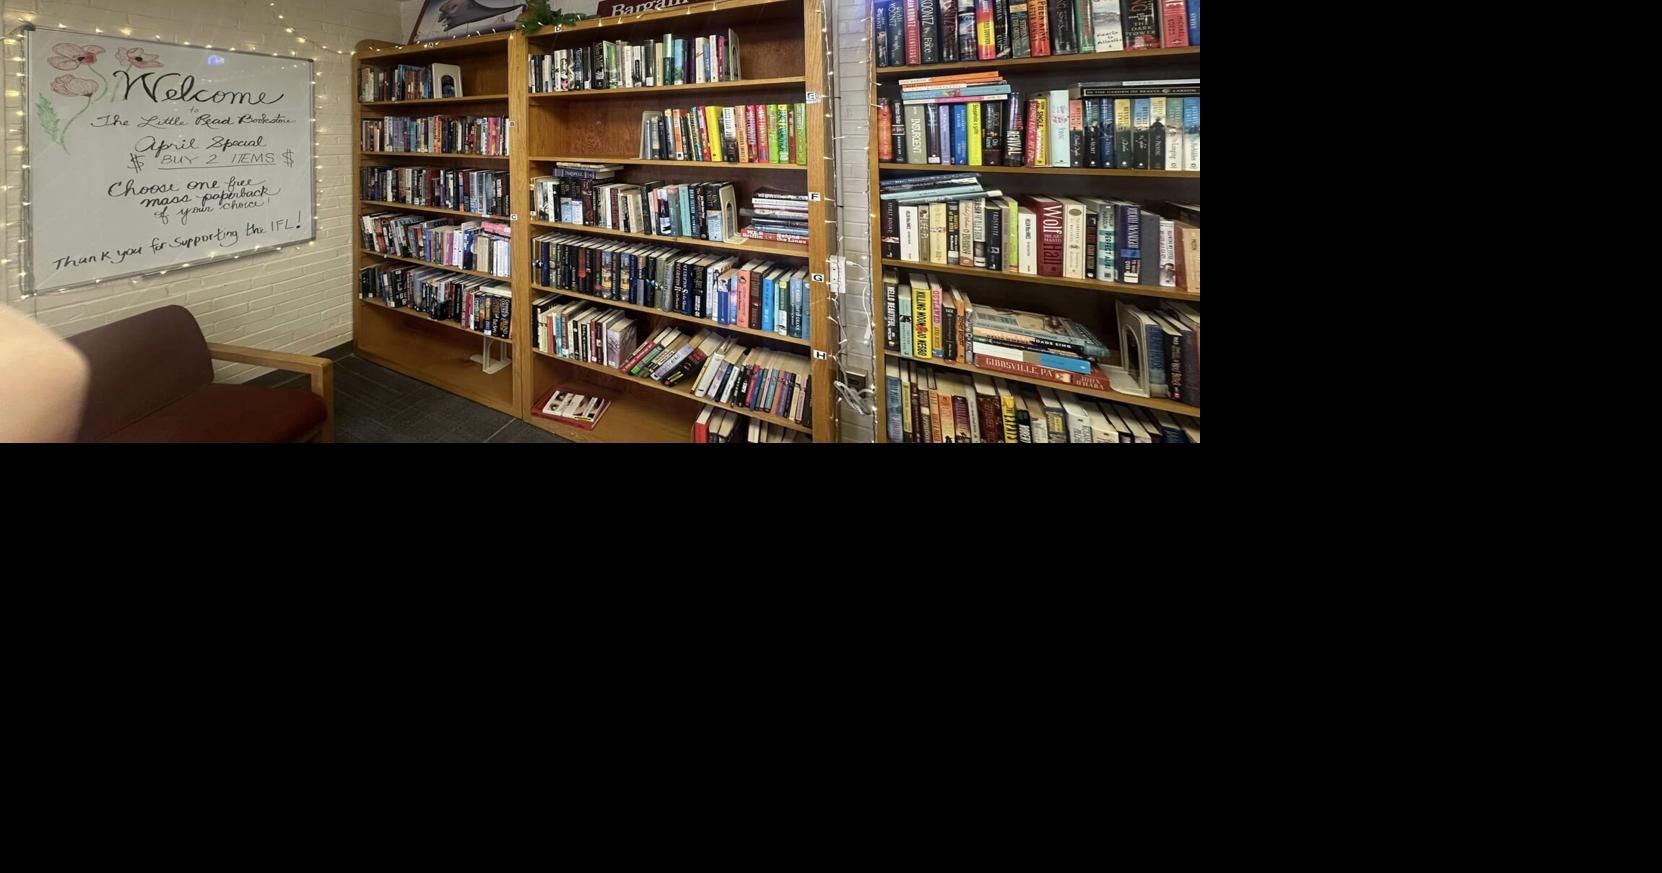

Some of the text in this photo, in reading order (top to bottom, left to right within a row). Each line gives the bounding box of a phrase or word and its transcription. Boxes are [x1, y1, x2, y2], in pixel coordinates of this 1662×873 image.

[113, 70, 285, 105] Welcome
[807, 92, 815, 100] E
[90, 115, 129, 127] The
[137, 114, 188, 128] Little
[189, 105, 199, 113] to
[911, 118, 922, 153] INSURGENT
[1007, 130, 1023, 156] REVIVAL
[134, 136, 267, 160] April Special
[127, 149, 294, 173] $ BUY 2 ITEMS $
[107, 176, 266, 198] Choose one free
[139, 186, 281, 208] mass paperback
[154, 204, 169, 225] of
[176, 204, 214, 226] your
[1043, 204, 1063, 234] Wolf
[53, 251, 112, 271] Thank
[109, 246, 144, 265] you
[150, 237, 167, 256] for
[245, 221, 267, 236] the
[1043, 243, 1063, 265] Hall
[887, 286, 896, 327] HELLO BEAUTIFUL
[916, 291, 927, 326] KILLING MOON
[932, 290, 941, 324] OUTLAWED
[816, 351, 825, 359] H
[1080, 375, 1101, 385] JOHN
